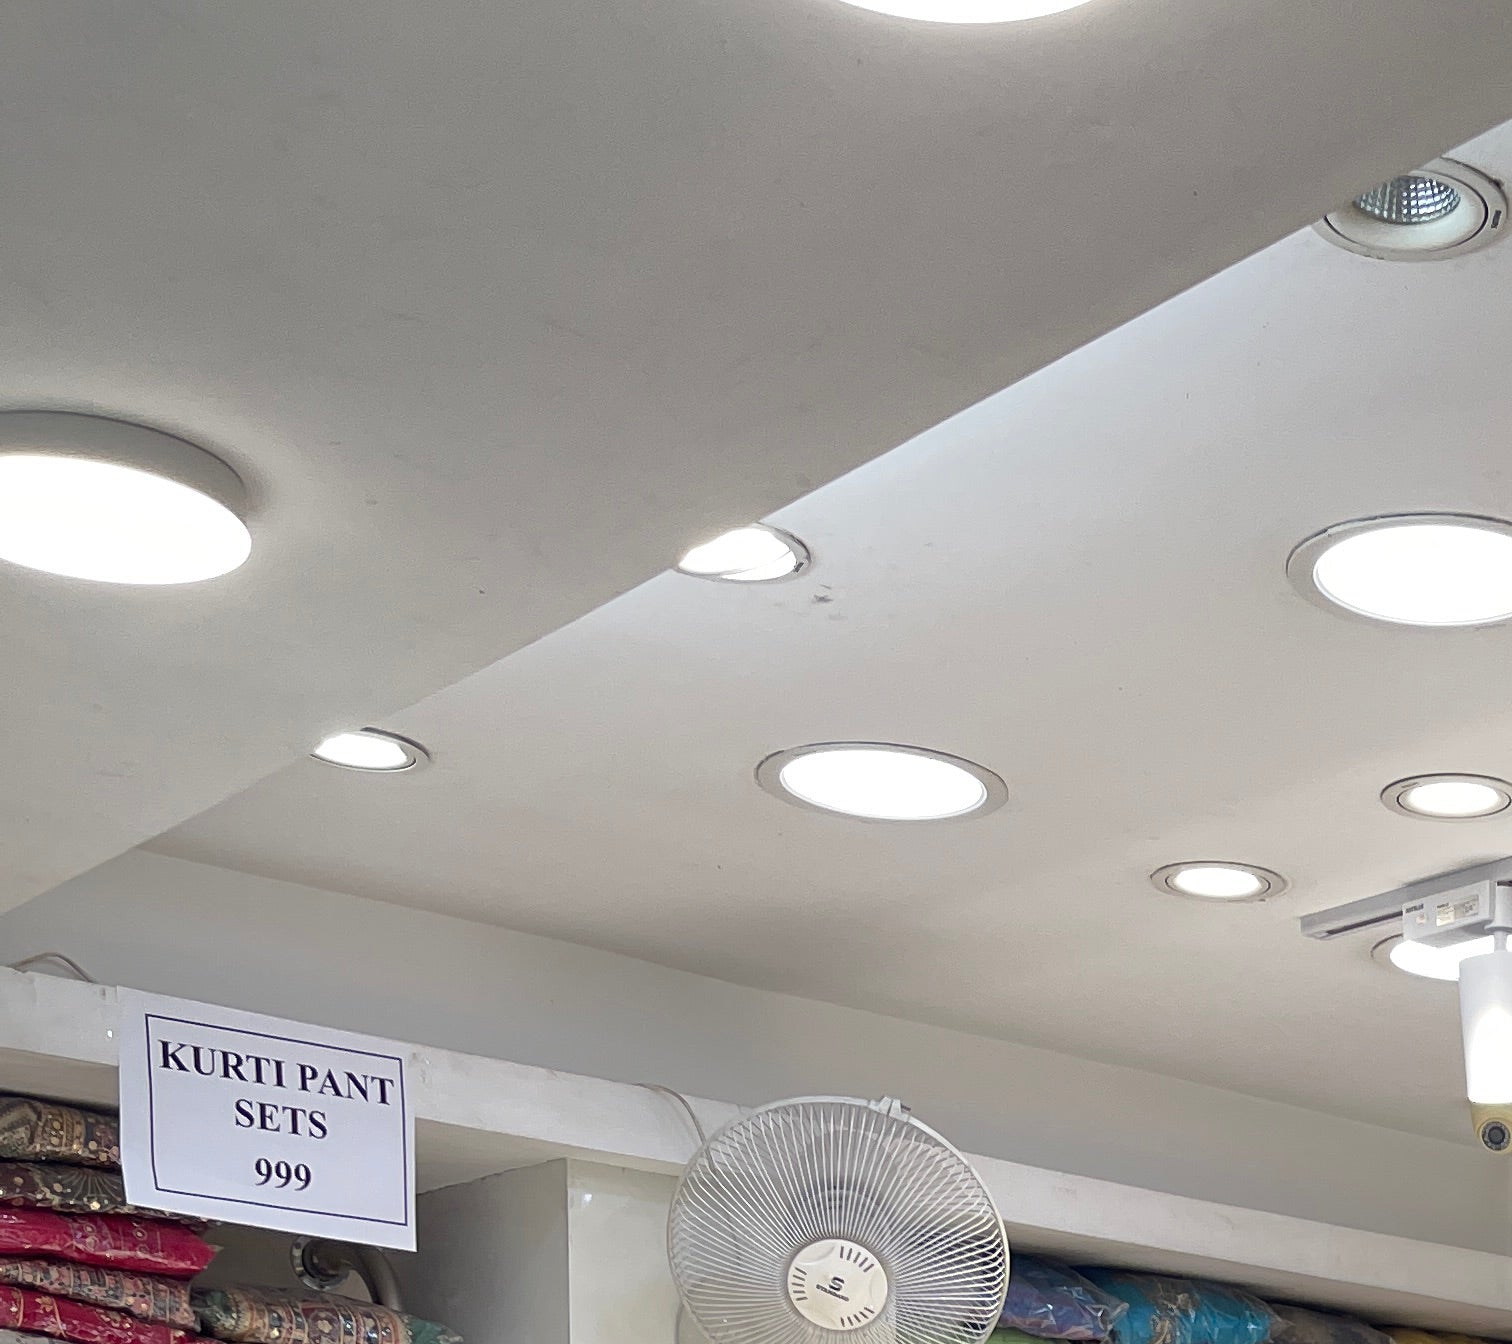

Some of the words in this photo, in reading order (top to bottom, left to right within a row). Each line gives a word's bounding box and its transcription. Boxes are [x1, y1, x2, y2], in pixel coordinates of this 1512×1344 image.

[157, 1040, 286, 1089] KURTI
[297, 1063, 394, 1105] PANT
[235, 1099, 328, 1140] SETS
[254, 1158, 312, 1192] 999
